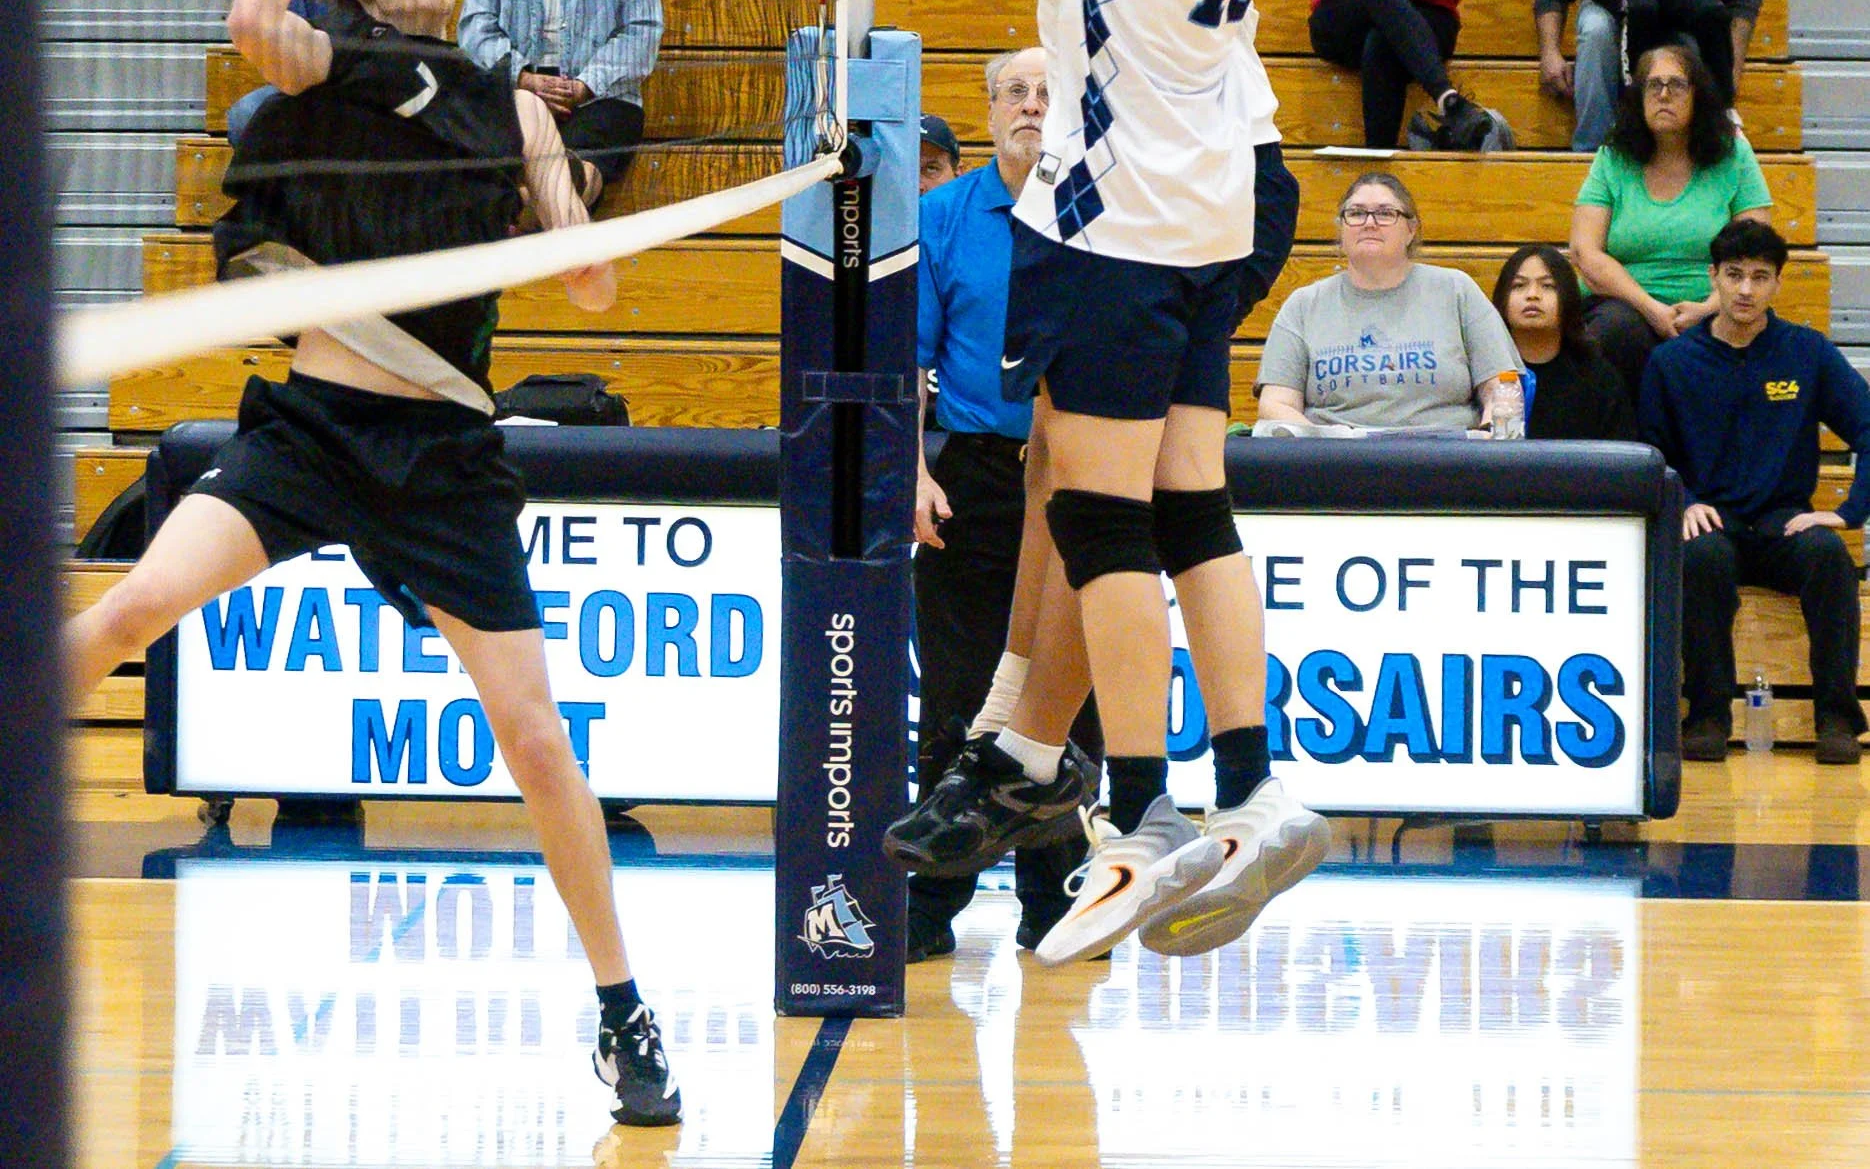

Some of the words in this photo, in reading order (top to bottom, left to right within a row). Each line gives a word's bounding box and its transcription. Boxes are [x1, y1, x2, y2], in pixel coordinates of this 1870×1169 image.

[837, 185, 860, 269] mports
[1315, 350, 1438, 381] CORSAIRS
[1316, 372, 1437, 396] SOFTBALL
[623, 517, 714, 569] TO
[1335, 555, 1436, 613] OF
[1461, 558, 1609, 616] THE
[825, 613, 858, 716] sports
[351, 697, 607, 787] MOT
[822, 722, 855, 849] imports
[790, 983, 821, 996] (800)
[823, 984, 876, 996] 556-3198
